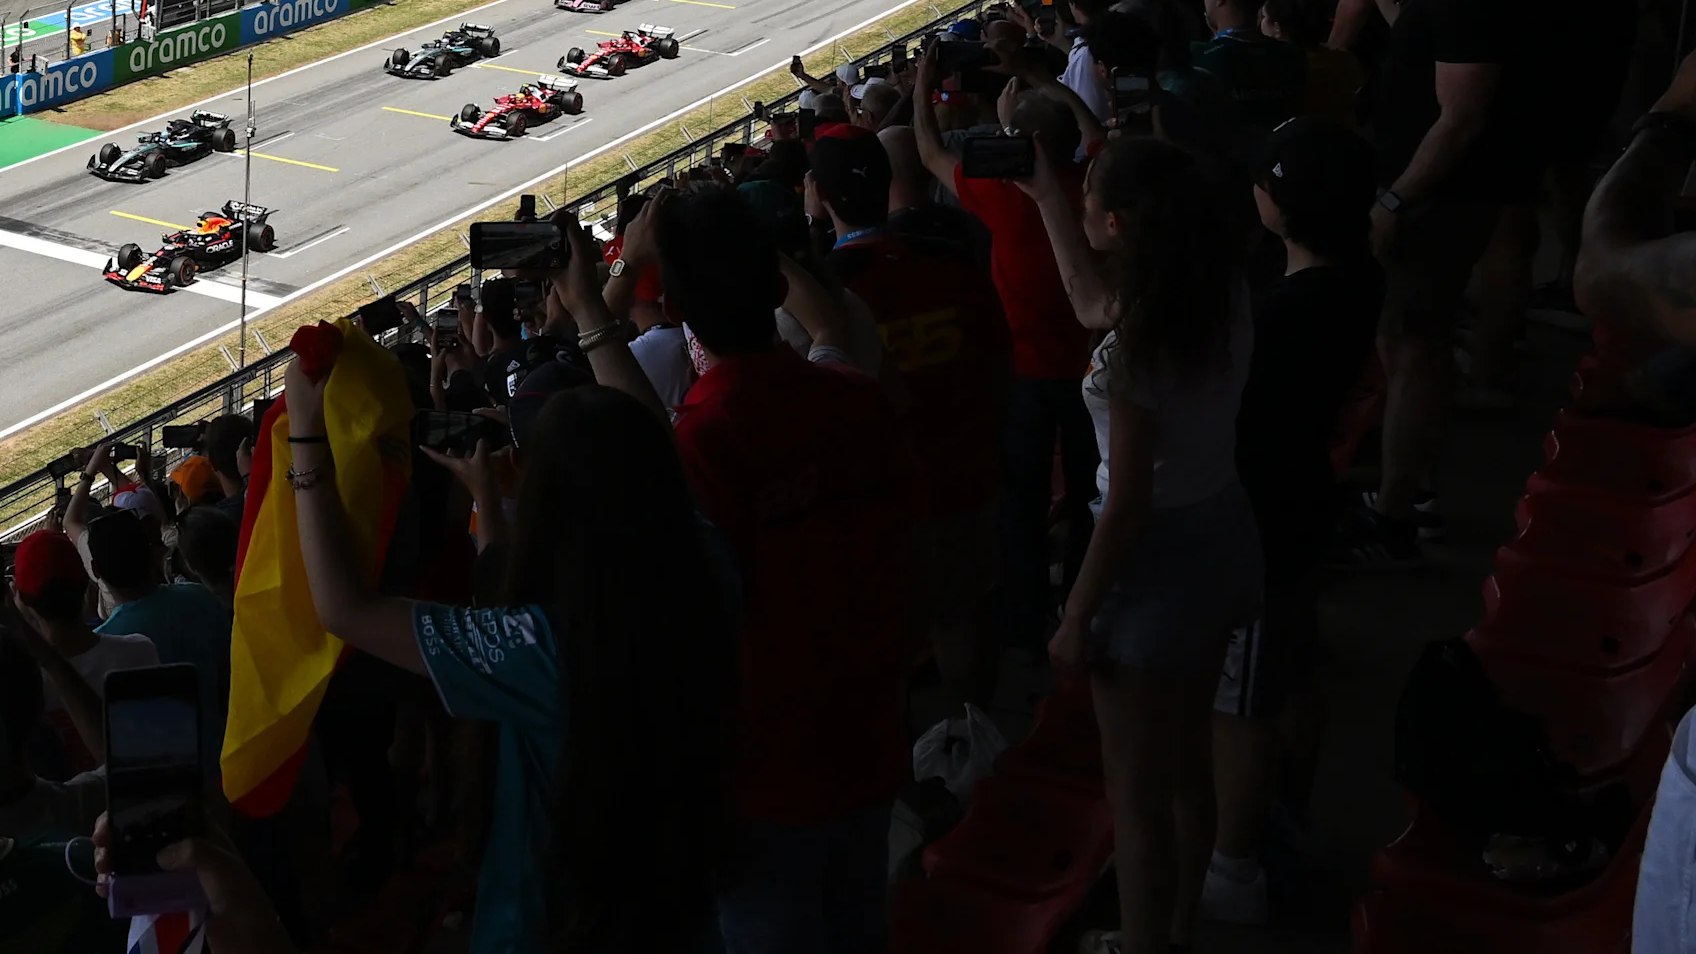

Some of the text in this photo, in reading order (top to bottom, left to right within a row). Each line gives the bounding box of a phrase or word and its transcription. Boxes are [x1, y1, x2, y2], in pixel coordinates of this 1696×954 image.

[129, 23, 226, 72] aramco
[19, 61, 97, 106] aramco
[206, 240, 233, 253] ORACLE
[421, 614, 441, 655] BOSS
